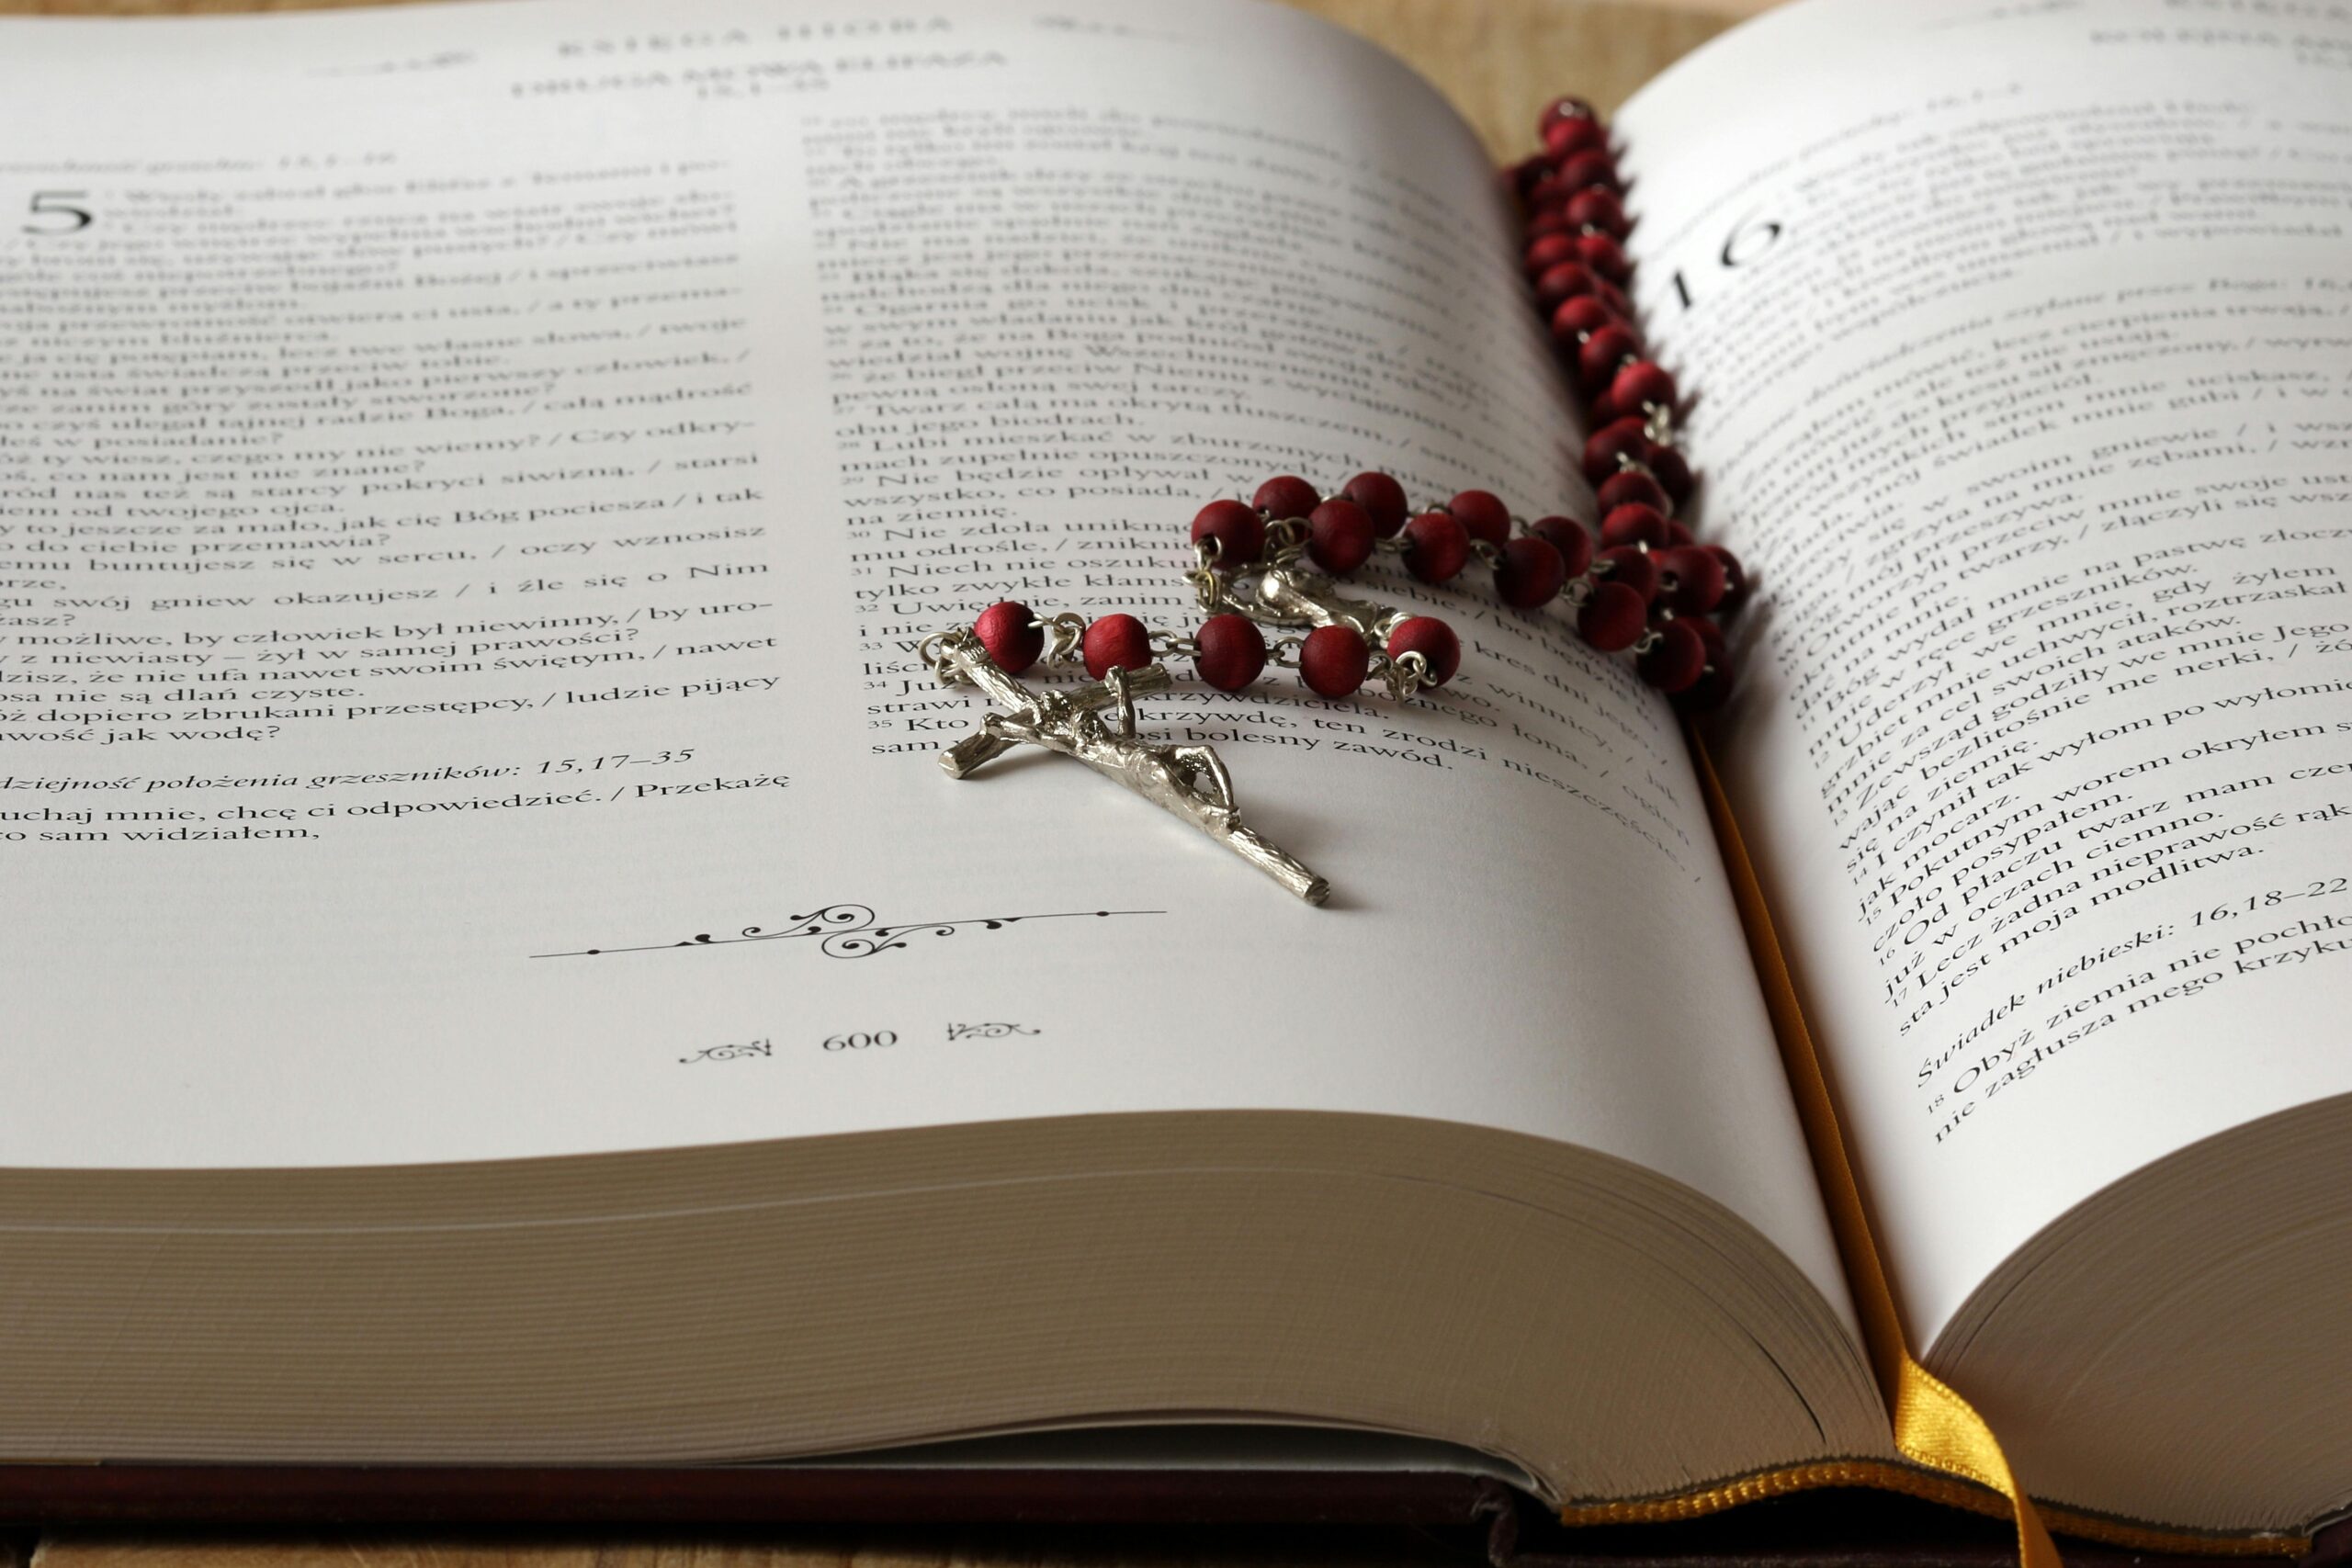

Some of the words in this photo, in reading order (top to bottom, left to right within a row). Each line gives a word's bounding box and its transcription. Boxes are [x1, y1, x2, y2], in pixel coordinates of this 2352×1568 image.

[21, 190, 94, 236] 5
[454, 510, 519, 524] Bóg
[529, 500, 664, 522] pociesza
[716, 488, 762, 502] tak
[847, 515, 884, 525] na
[884, 527, 945, 541] Nie
[961, 519, 1051, 536] zdoła
[89, 554, 254, 574] buntujesz
[272, 557, 314, 570] się
[333, 558, 360, 566] w
[520, 542, 595, 555] oczy
[613, 526, 764, 547] wznosisz
[851, 550, 906, 562] mu
[916, 538, 1049, 558] odrośle,
[888, 559, 992, 578] Niech
[1006, 558, 1050, 570] nie
[54, 596, 130, 615] swój
[151, 595, 254, 611] gniew
[274, 589, 437, 604] okazujesz
[490, 582, 497, 594] i
[518, 579, 563, 592] źle
[584, 574, 627, 588] się
[648, 573, 667, 581] o
[689, 564, 768, 579] Nim
[854, 583, 940, 602] tylko
[953, 575, 1070, 593] zwykłe
[1080, 592, 1182, 605] zanim
[2153, 580, 2211, 603] gdy
[2232, 563, 2336, 586] żyłem
[17, 633, 172, 646] możliwe,
[184, 632, 223, 648] by
[233, 626, 384, 643] człowiek
[393, 623, 444, 639] był
[456, 615, 618, 634] niewinny,
[649, 607, 689, 622] by
[699, 603, 772, 615] uro-
[21, 655, 37, 663] z
[51, 647, 213, 667] niewiasty
[257, 648, 305, 665] żył
[318, 650, 348, 659] w
[361, 641, 456, 658] samej
[470, 626, 639, 656] prawości?
[882, 622, 934, 635] nie
[2001, 610, 2158, 669] uchwycił,
[2168, 581, 2347, 616] roztrzaskał
[89, 671, 124, 682] że
[135, 670, 186, 682] nie
[197, 665, 249, 682] ufa
[259, 663, 360, 681] nawet
[370, 655, 482, 676] swoim
[493, 651, 645, 670] świętym,
[676, 637, 776, 655] nawet
[1992, 644, 2106, 695] swoich
[2118, 615, 2242, 649] ataków.
[37, 709, 172, 726] dopiero
[183, 705, 335, 720] zbrukani
[346, 698, 533, 719] przestępcy,
[566, 685, 671, 704] ludzie
[681, 677, 780, 697] pijący
[55, 690, 107, 702] nie
[120, 694, 153, 705] są
[164, 688, 238, 701] dlań
[251, 688, 364, 702] czyste.
[867, 695, 973, 715] strawi
[1857, 713, 1983, 810] Zewsząd
[1992, 665, 2109, 722] godziły
[2119, 649, 2167, 669] we
[2177, 631, 2266, 655] mnie
[2273, 623, 2349, 643] Jego
[1919, 692, 2090, 781] bezlitośnie
[2106, 673, 2159, 695] me
[2174, 649, 2274, 677] nerki,
[100, 728, 157, 745] jak
[167, 726, 280, 741] wodę?
[867, 719, 892, 729] 35
[905, 717, 969, 732] Kto
[1137, 707, 1297, 728] krzywdę,
[1312, 718, 1369, 734] ten
[1383, 728, 1487, 761] zrodzi
[872, 741, 941, 754] sam
[1185, 727, 1320, 750] bolesny
[1333, 741, 1453, 769] zawód.
[141, 774, 298, 793] położenia
[305, 765, 520, 789] grzeszników:
[1886, 805, 1919, 833] na
[1928, 739, 2038, 802] ziemię.
[1894, 784, 1977, 852] czynił
[1985, 761, 2033, 789] tak
[2038, 716, 2154, 763] wyłom
[2162, 705, 2205, 726] po
[2052, 755, 2173, 802] worem
[2181, 723, 2327, 761] okryłem
[105, 808, 207, 823] mnie,
[217, 805, 296, 823] chcę
[308, 804, 335, 817] ci
[347, 789, 601, 818] odpowiedzieć.
[635, 773, 790, 797] Przekażę
[40, 832, 110, 840] sam
[121, 826, 319, 840] widziałem,
[1902, 795, 2019, 870] mocarz.
[1873, 886, 1942, 953] czoło
[1951, 792, 2133, 888] posypałem.
[1904, 902, 1951, 946] Od
[1961, 840, 2064, 907] płaczu
[2077, 801, 2171, 840] twarz
[2184, 775, 2276, 804] mam
[1933, 923, 1959, 946] w
[1968, 858, 2075, 922] oczach
[2086, 810, 2224, 861] ciemno.
[1917, 933, 1983, 989] Lecz
[1990, 879, 2083, 934] żadna
[2090, 813, 2287, 882] nieprawość
[1899, 999, 1934, 1036] sta
[1939, 953, 1992, 1005] jest
[1998, 903, 2080, 955] moja
[2089, 844, 2265, 907] modlitwa.
[1917, 993, 2027, 1089] Świadek
[2036, 923, 2175, 994] niebieski:
[1953, 1028, 2035, 1094] Obyż
[2046, 970, 2157, 1030] ziemia
[2168, 947, 2222, 974] nie
[823, 1031, 898, 1052] 600
[1934, 1101, 1975, 1145] nie
[1984, 1011, 2117, 1100] zagłusza
[2127, 971, 2224, 1015] mego
